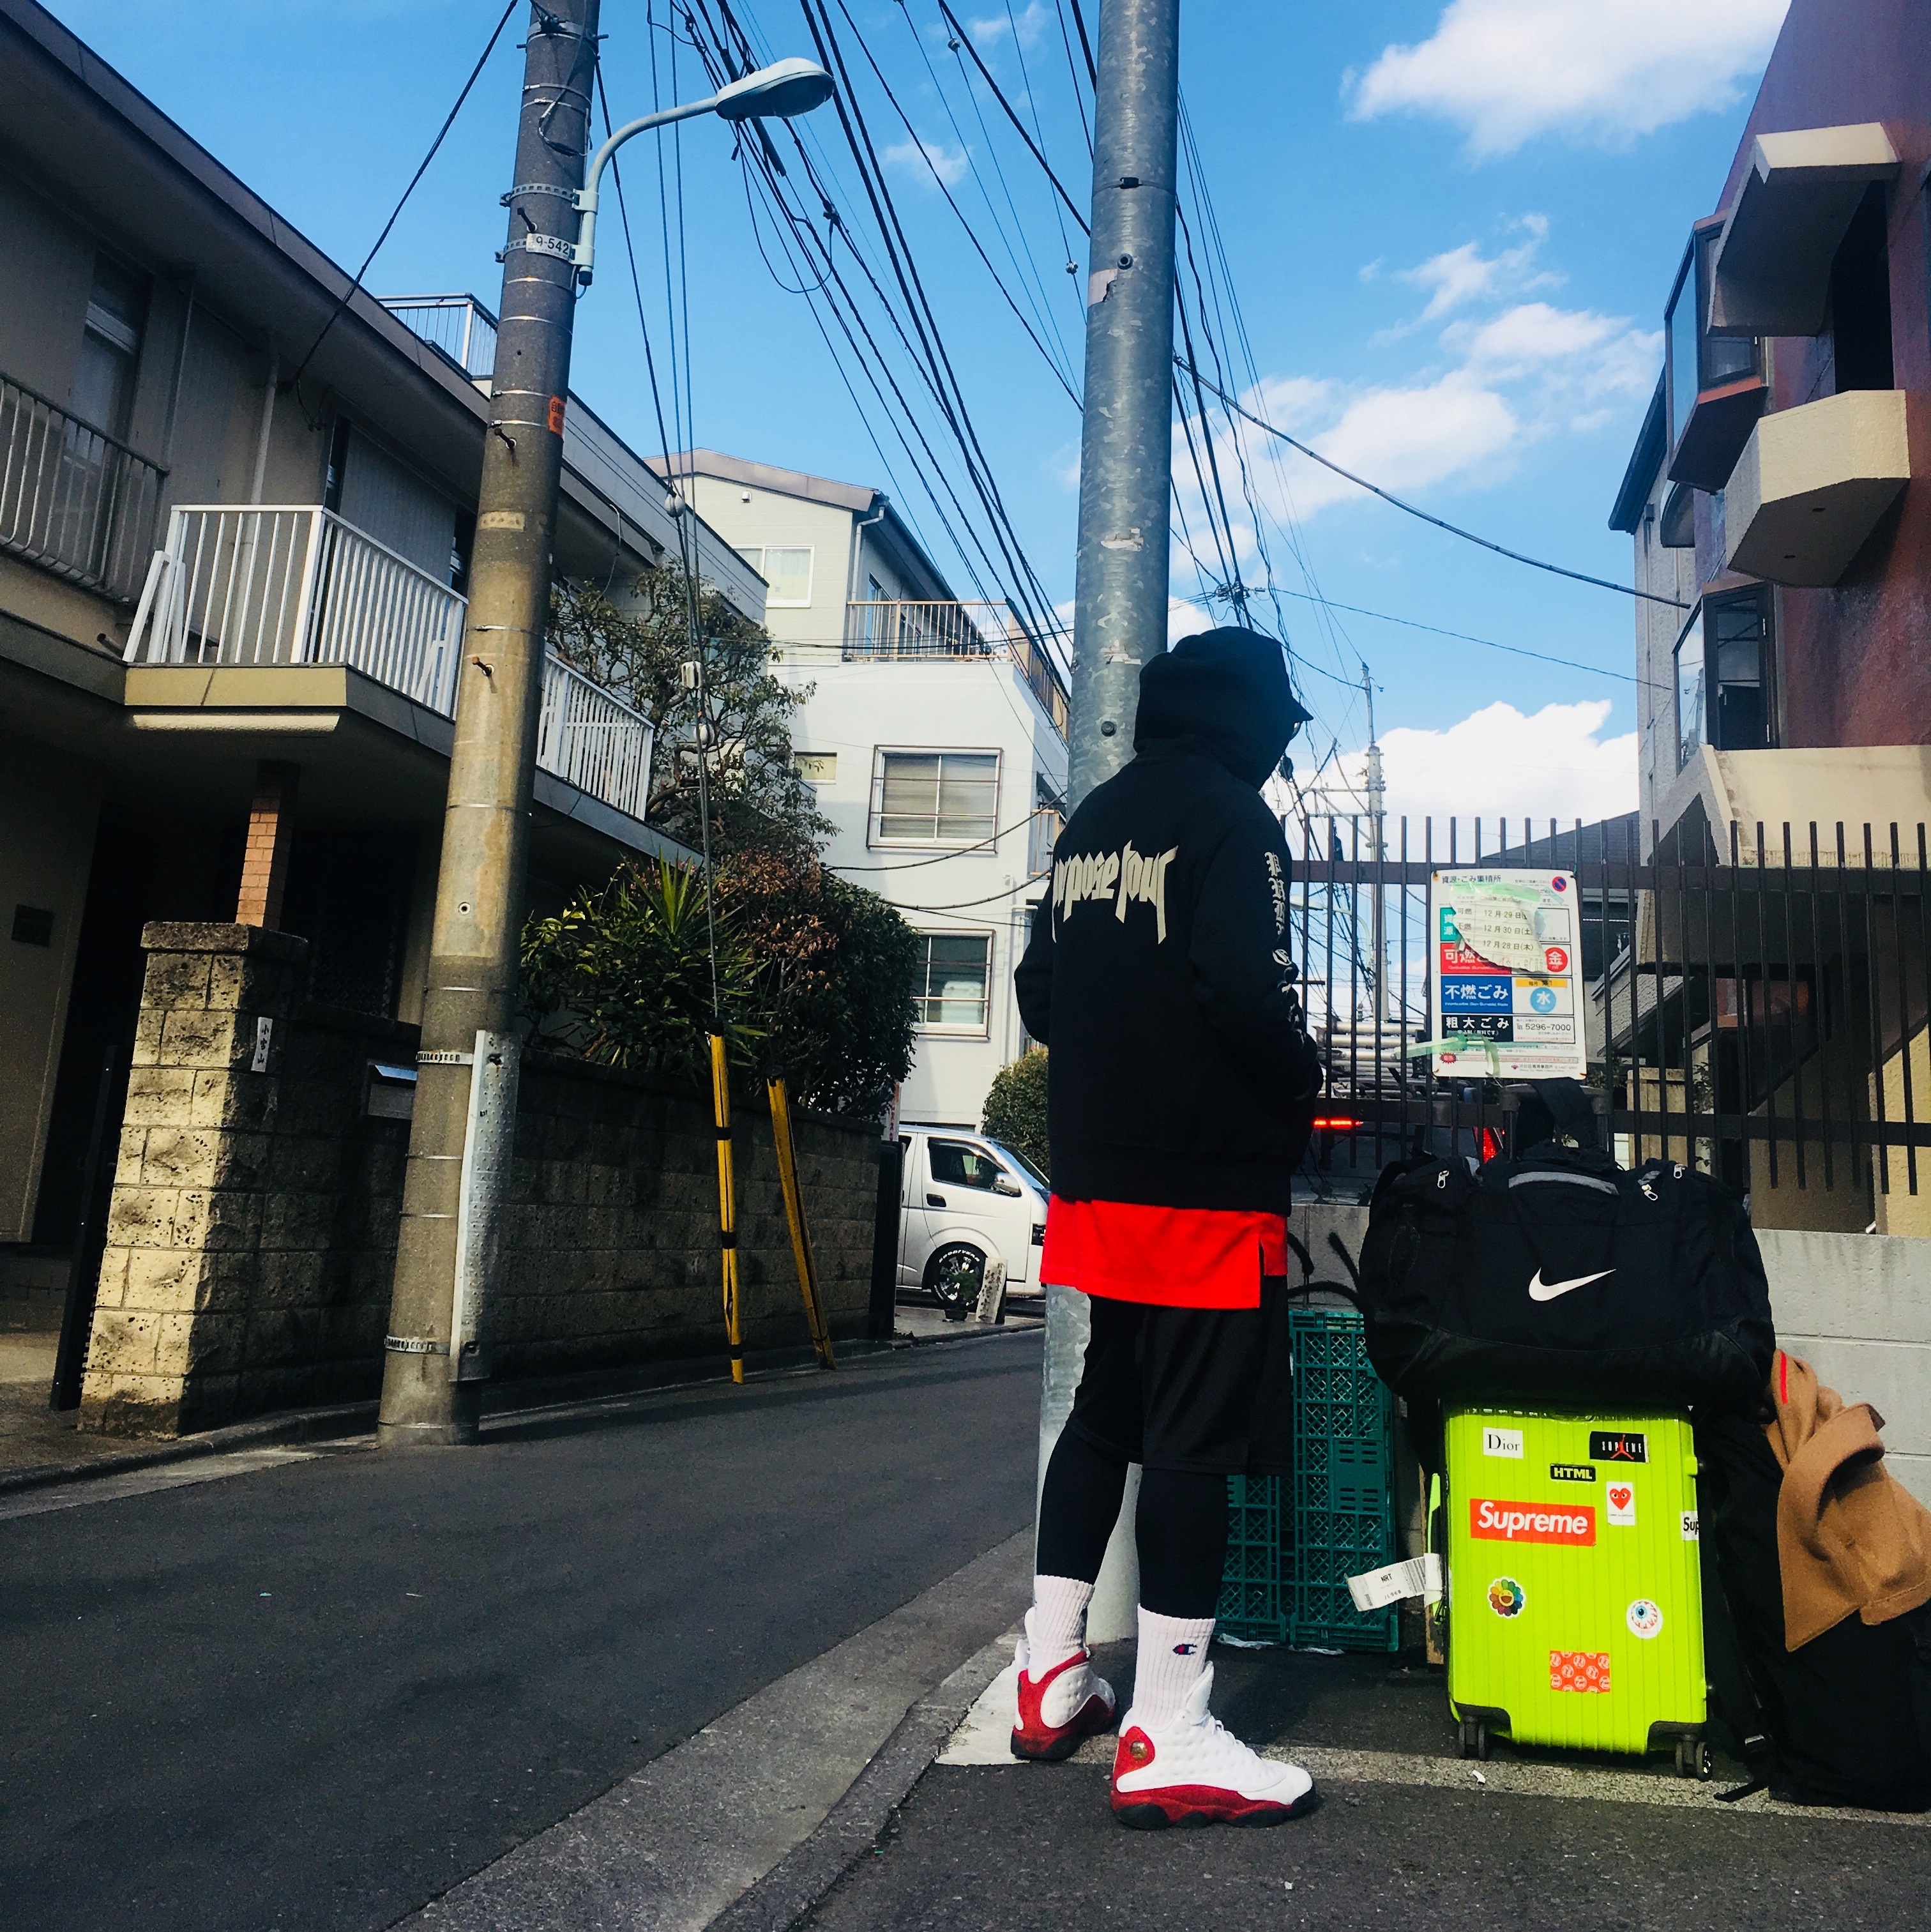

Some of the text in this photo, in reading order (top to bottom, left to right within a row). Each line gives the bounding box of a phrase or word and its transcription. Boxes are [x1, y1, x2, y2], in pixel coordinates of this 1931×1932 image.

[536, 236, 570, 255] 9-542
[1548, 951, 1563, 965] 金
[1444, 984, 1509, 1000] 不燃ごみ
[1536, 991, 1550, 1005] 水
[1446, 1016, 1510, 1030] 粗大ごみ
[1525, 1023, 1571, 1031] 5296-7000
[1487, 1434, 1520, 1451] Dior
[1602, 1441, 1642, 1453] SUPEME
[1554, 1467, 1593, 1480] HTML
[1477, 1501, 1589, 1539] Supreme
[1381, 1573, 1393, 1583] NRT
